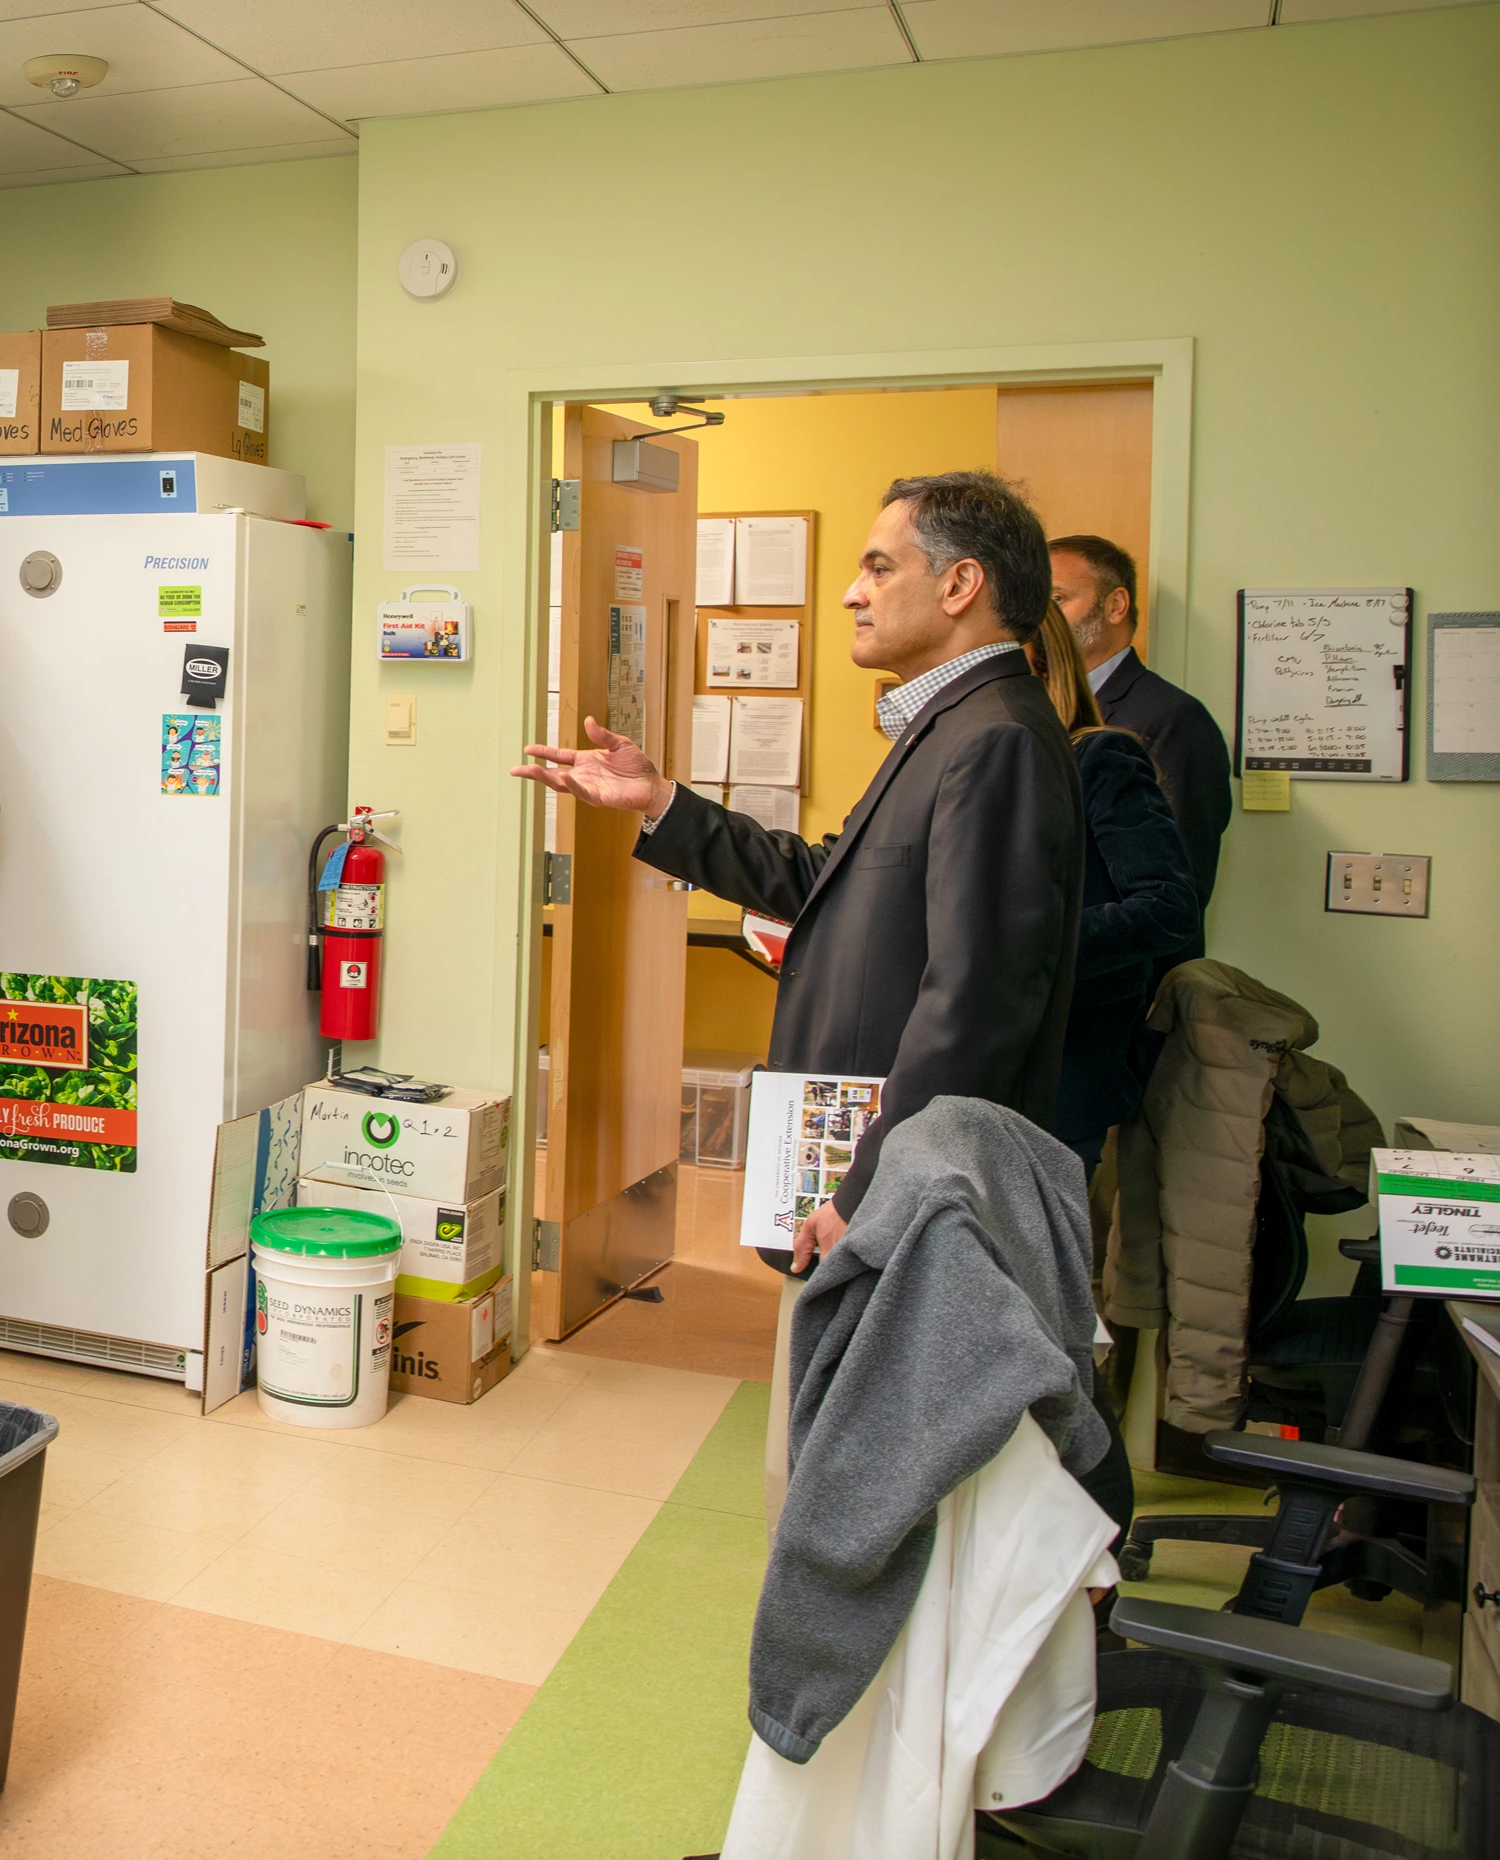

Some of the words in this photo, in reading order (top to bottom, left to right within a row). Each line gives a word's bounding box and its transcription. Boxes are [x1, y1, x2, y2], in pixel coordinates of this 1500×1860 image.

[50, 417, 82, 442] Med
[88, 418, 138, 439] Gloves
[189, 664, 218, 674] MILLER
[3, 1103, 51, 1137] fresh
[53, 1113, 106, 1134] PRODUCE
[310, 1102, 349, 1121] Martin
[784, 1100, 795, 1144] Extension
[344, 1146, 415, 1177] incotec
[386, 1178, 408, 1188] seeds
[780, 1147, 793, 1204] Cooperative
[1411, 1205, 1482, 1217] TINGLEY
[1408, 1222, 1450, 1237] TeeJet
[423, 1240, 440, 1248] ZADEN
[1454, 1254, 1500, 1264] ETHANE
[269, 1298, 289, 1311] SEED
[294, 1304, 351, 1316] DYNAMICS
